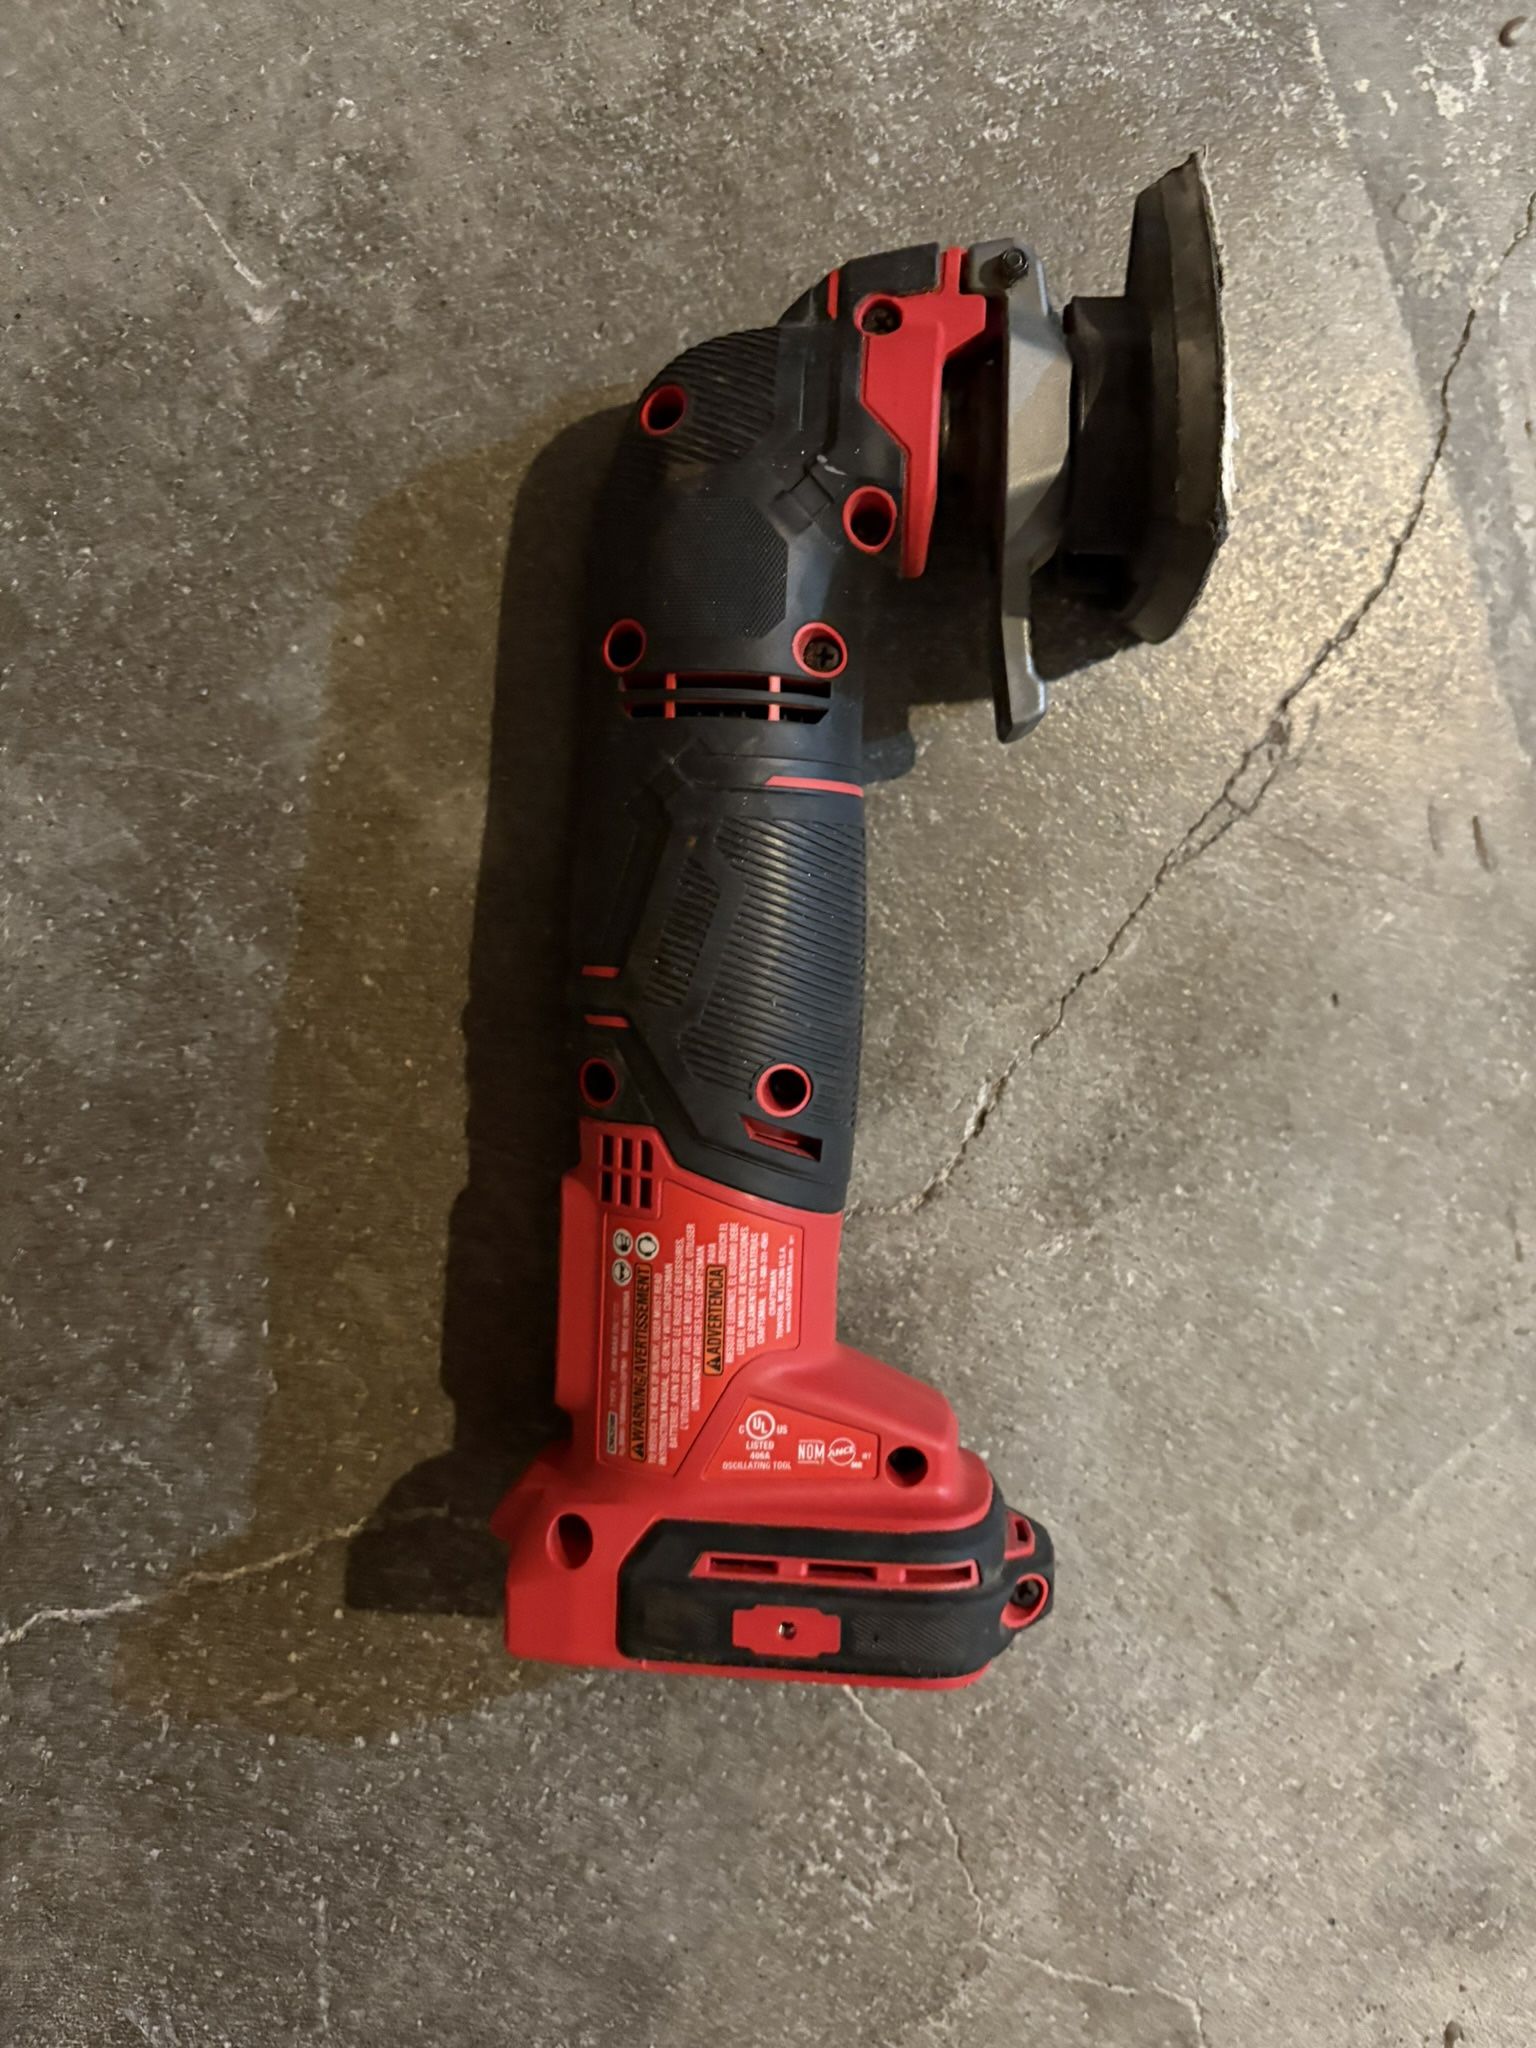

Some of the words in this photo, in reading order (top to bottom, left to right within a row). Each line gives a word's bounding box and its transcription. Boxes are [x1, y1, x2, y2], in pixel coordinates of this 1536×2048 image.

[719, 1223, 728, 1231] EL
[729, 1223, 738, 1242] DEBE
[685, 1223, 695, 1258] UTILISER
[718, 1232, 727, 1264] REDUCIR
[728, 1243, 738, 1275] USUARIO
[654, 1273, 662, 1294] READ
[728, 1276, 737, 1286] EL
[749, 1269, 758, 1286] CON
[663, 1264, 673, 1311] CRAFTSMAN
[674, 1285, 682, 1295] DE
[738, 1286, 747, 1296] DE
[769, 1269, 778, 1316] CRAFTSMAN
[777, 1288, 784, 1302] MD
[653, 1296, 661, 1318] MUST
[673, 1297, 682, 1326] RISQUE
[683, 1300, 692, 1324] MODE
[694, 1295, 703, 1318] PILES
[706, 1268, 724, 1355] ADVERTENCIA
[737, 1296, 746, 1328] MANUAL
[748, 1287, 757, 1332] SOLAMENTE
[652, 1319, 661, 1341] USER
[663, 1312, 671, 1333] WITH
[673, 1327, 681, 1337] LE
[683, 1325, 691, 1335] LE
[693, 1318, 702, 1336] DES
[726, 1325, 735, 1335] DE
[736, 1328, 745, 1336] EL
[662, 1334, 671, 1357] ONLY
[683, 1336, 691, 1353] LIRE
[693, 1335, 702, 1357] AVEC
[736, 1337, 745, 1355] LEER
[747, 1332, 756, 1348] USE
[633, 1268, 648, 1440] WARNING/AVERTISSEMENT
[682, 1353, 691, 1373] DOIT
[662, 1359, 670, 1373] USE
[651, 1374, 659, 1384] OF
[671, 1372, 679, 1383] DE
[671, 1384, 679, 1403] AFIN
[753, 1417, 768, 1434] UL
[777, 1425, 788, 1434] US
[649, 1422, 657, 1452] REDUCE
[659, 1413, 668, 1465] INSTRUCTION
[746, 1441, 775, 1450] LISTED
[798, 1444, 824, 1459] NOM
[722, 1461, 771, 1470] OSCILLATING
[773, 1461, 791, 1470] TOOL
